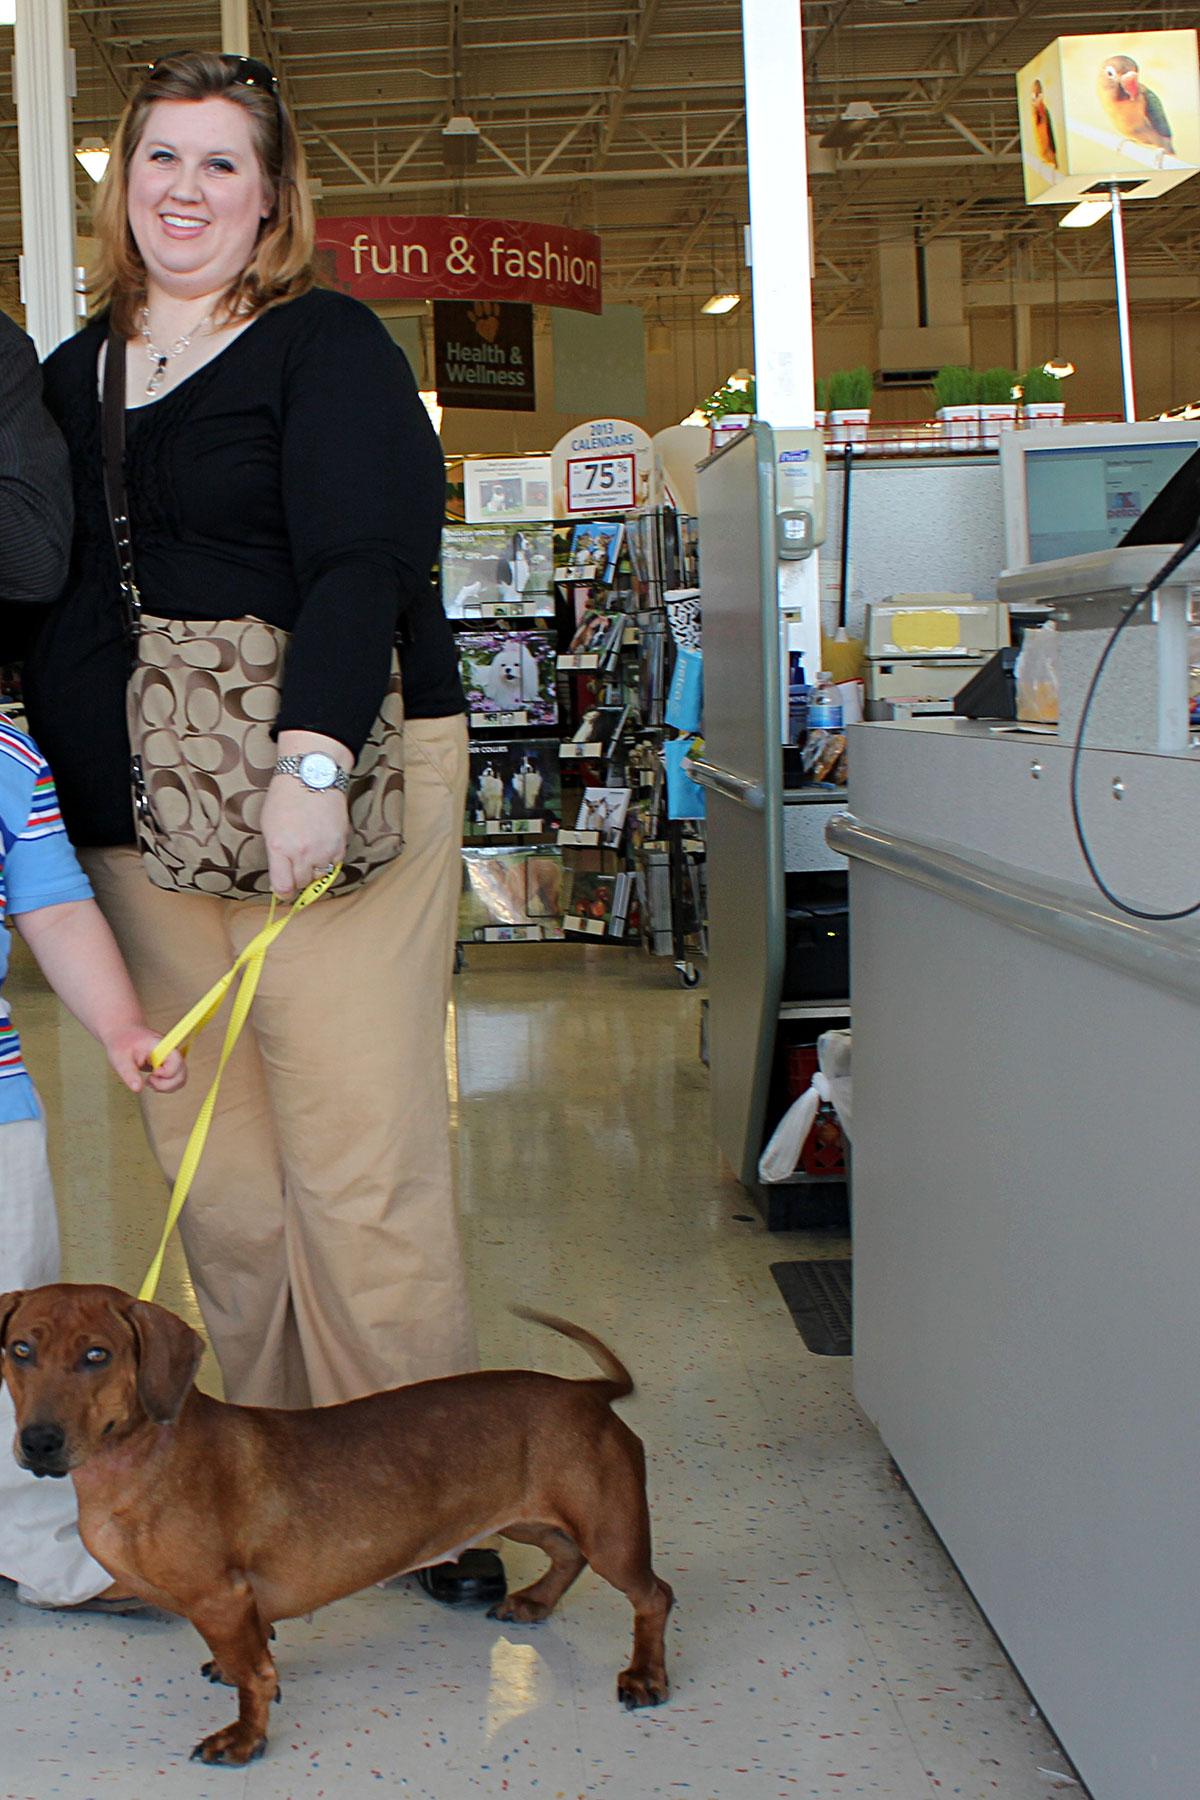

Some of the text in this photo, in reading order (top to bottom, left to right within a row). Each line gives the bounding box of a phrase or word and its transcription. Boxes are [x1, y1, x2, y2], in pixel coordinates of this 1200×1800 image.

[351, 234, 597, 289] fun & fashion
[446, 342, 523, 365] Health &
[445, 362, 526, 387] Wellness
[590, 422, 615, 437] 2013
[571, 432, 634, 452] CALENDARS
[584, 462, 615, 491] 75
